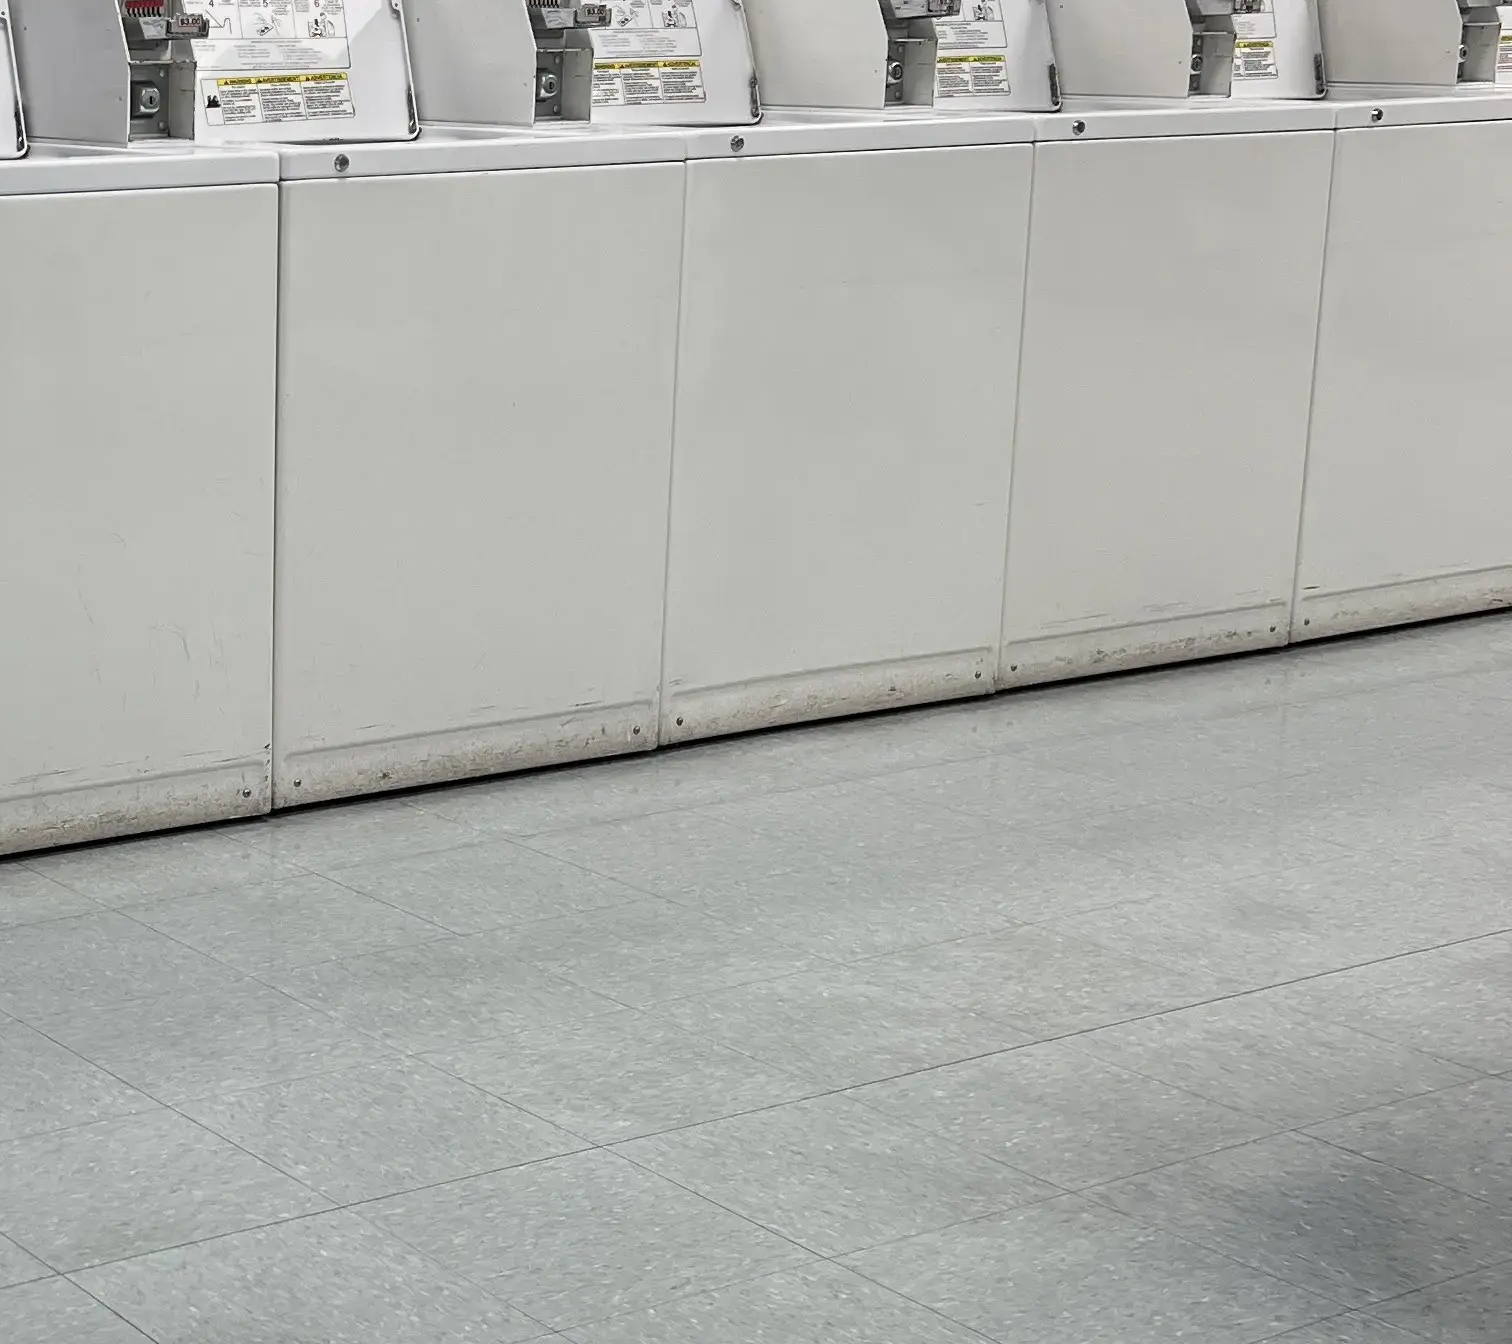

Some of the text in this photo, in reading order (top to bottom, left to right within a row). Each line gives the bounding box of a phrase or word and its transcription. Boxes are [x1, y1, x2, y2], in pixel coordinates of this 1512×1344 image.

[208, 0, 215, 8] 4
[262, 0, 268, 8] 5
[314, 0, 320, 8] 6
